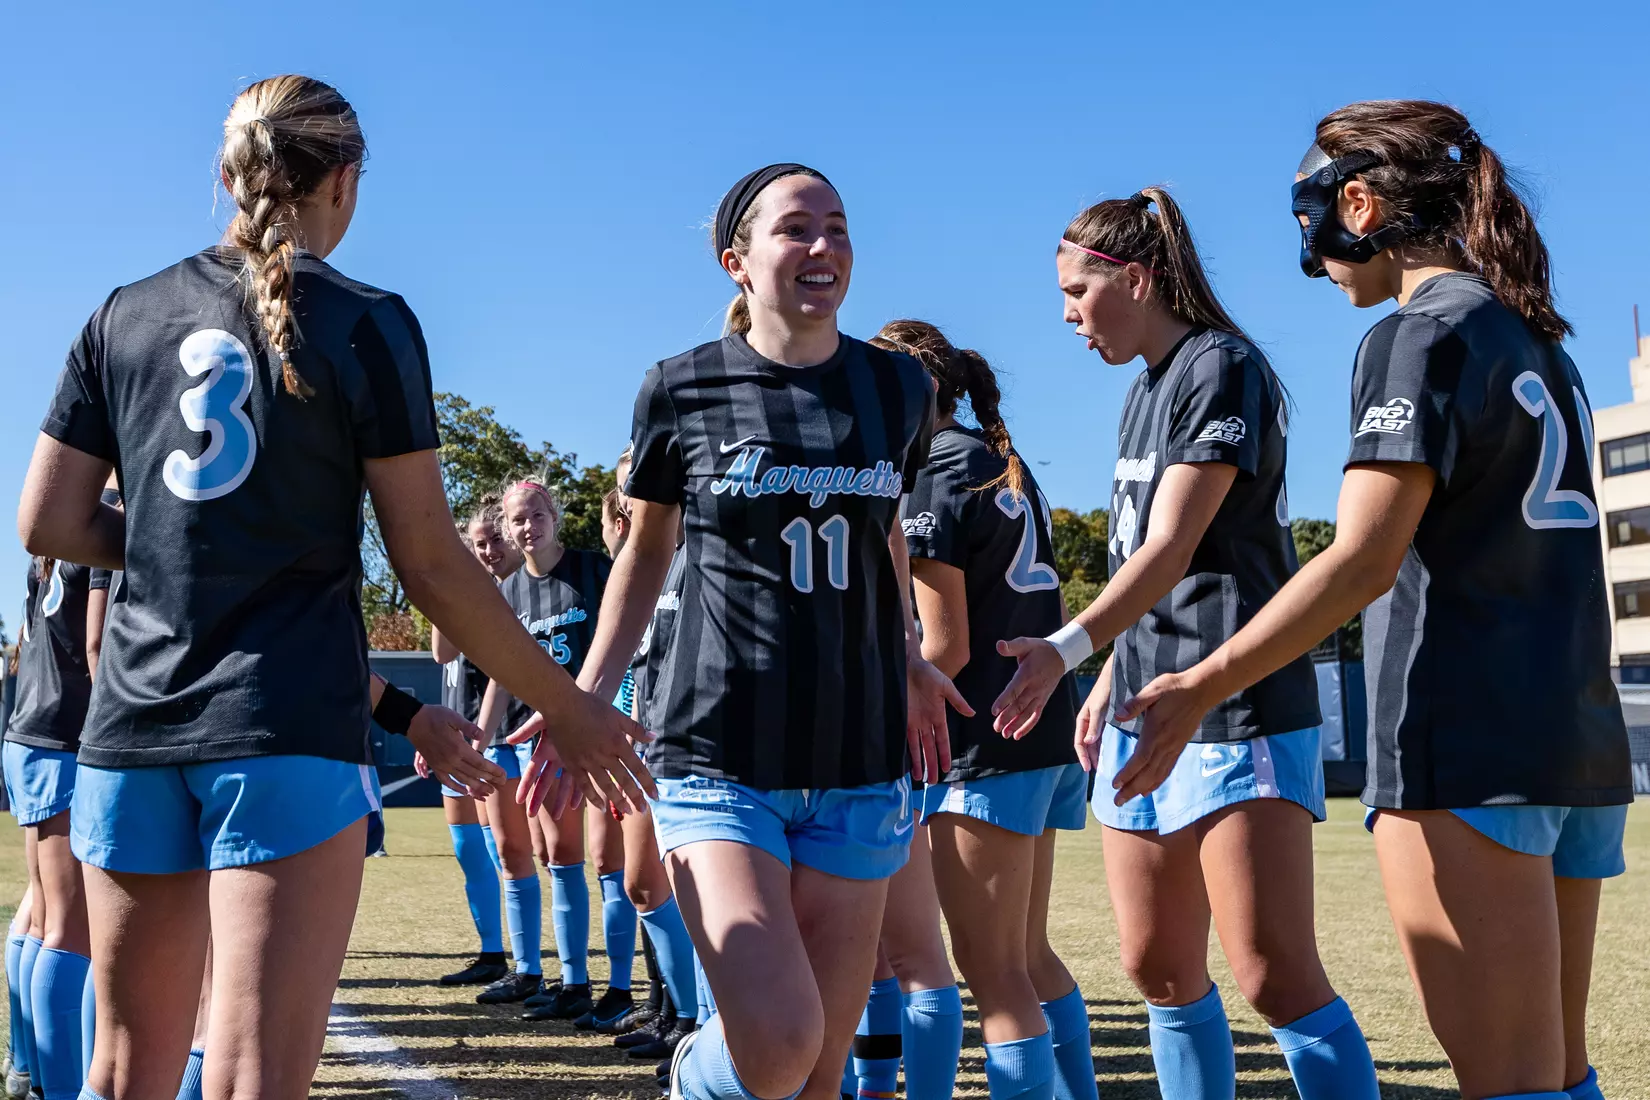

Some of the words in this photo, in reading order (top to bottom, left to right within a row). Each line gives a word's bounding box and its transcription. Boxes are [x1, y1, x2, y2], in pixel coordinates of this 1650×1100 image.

[162, 328, 257, 501] 3
[1363, 405, 1406, 420] BIG
[1205, 420, 1240, 433] BIG
[1358, 418, 1412, 431] EAST
[1198, 429, 1245, 443] EAST
[710, 447, 903, 509] Marquette
[901, 516, 931, 527] BIG
[780, 514, 850, 593] 11
